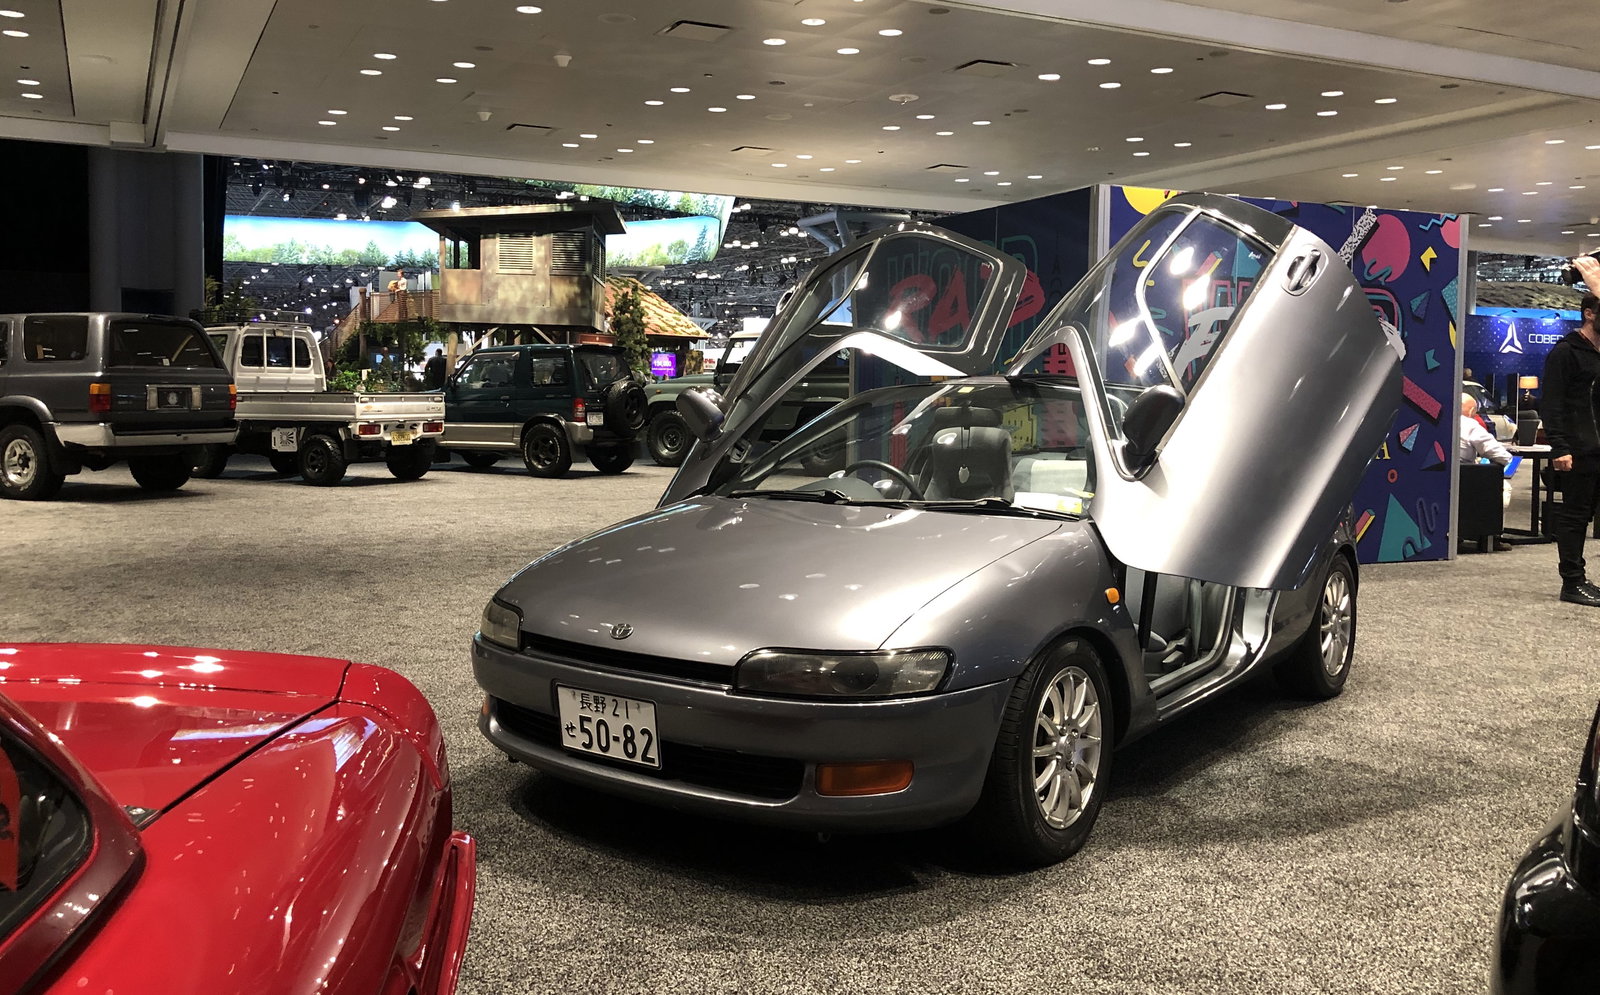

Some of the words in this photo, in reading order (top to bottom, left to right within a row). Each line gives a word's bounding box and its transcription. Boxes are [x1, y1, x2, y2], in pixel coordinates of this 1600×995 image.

[580, 692, 606, 714] 長野
[612, 698, 630, 719] 21
[565, 721, 577, 738] せ
[579, 714, 655, 764] 50-82
